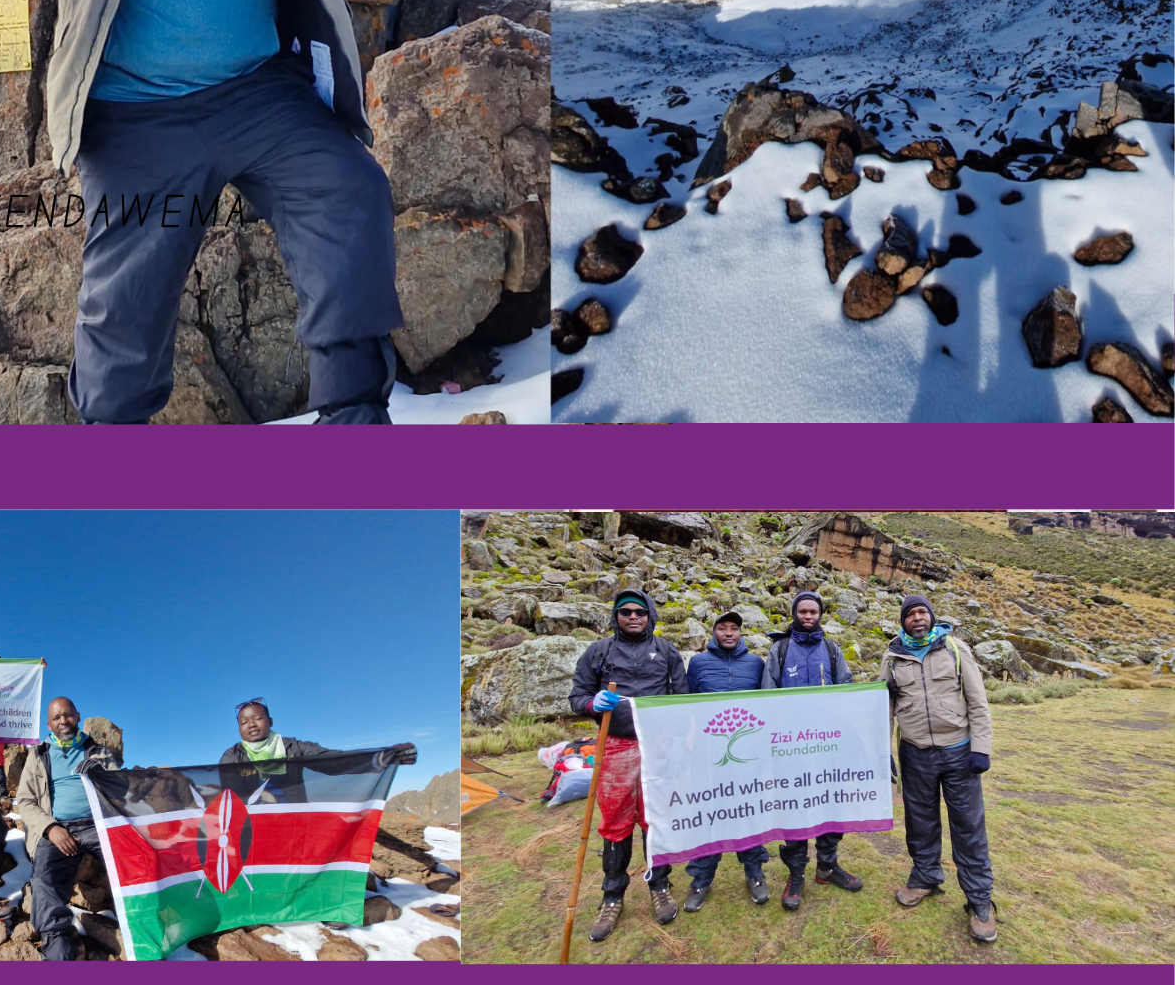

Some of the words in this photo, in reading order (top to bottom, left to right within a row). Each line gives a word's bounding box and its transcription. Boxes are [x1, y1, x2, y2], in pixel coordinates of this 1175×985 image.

[8, 720, 33, 730] thrive
[770, 731, 792, 744] Zizi
[796, 728, 842, 743] Afrique
[771, 742, 839, 758] Foundation
[669, 791, 684, 808] A
[685, 781, 735, 804] world
[738, 776, 790, 796] where
[794, 772, 811, 788] all
[815, 768, 875, 785] children
[671, 812, 703, 832] and
[706, 799, 755, 826] youth
[759, 798, 799, 815] learn
[803, 790, 830, 809] and
[833, 787, 877, 804] thrive
